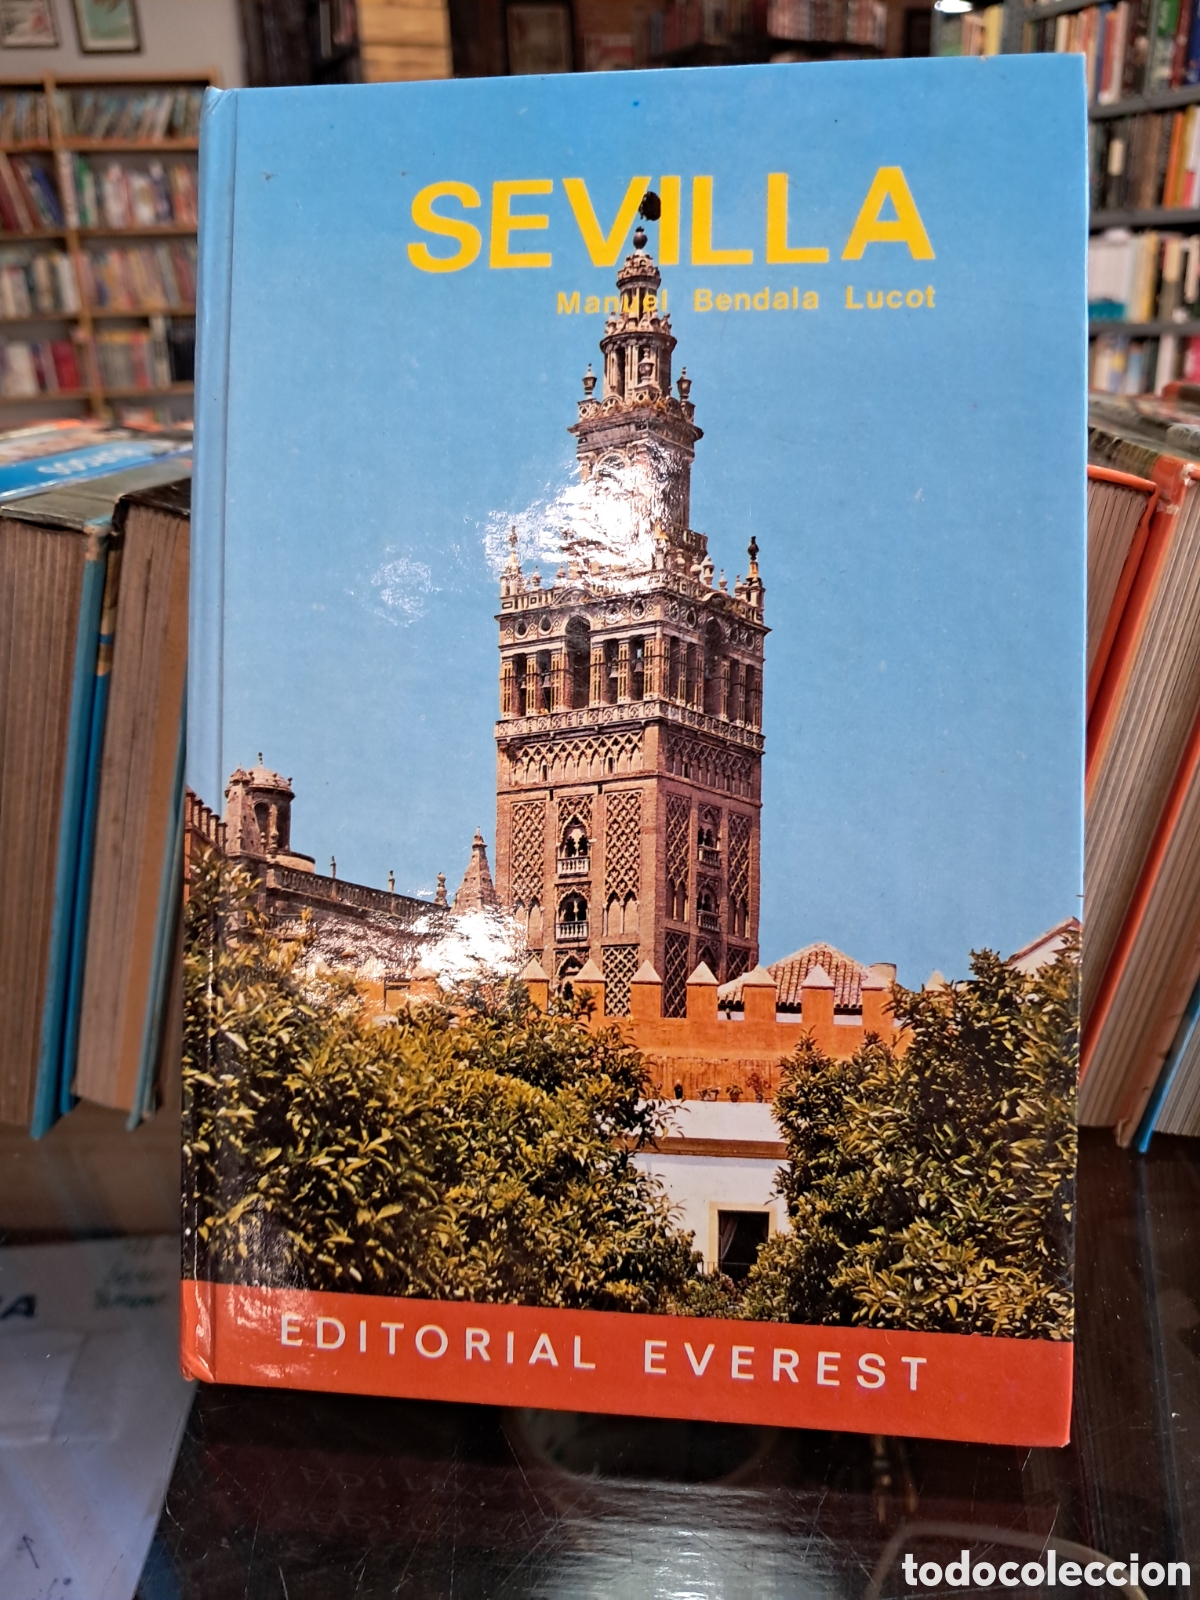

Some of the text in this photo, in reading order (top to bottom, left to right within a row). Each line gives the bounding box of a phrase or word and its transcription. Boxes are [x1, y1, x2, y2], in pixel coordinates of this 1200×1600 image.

[407, 165, 936, 274] SEVILLA
[556, 285, 936, 315] Manuel Bendala Lucot
[280, 1313, 928, 1391] EDITORIAL EVEREST
